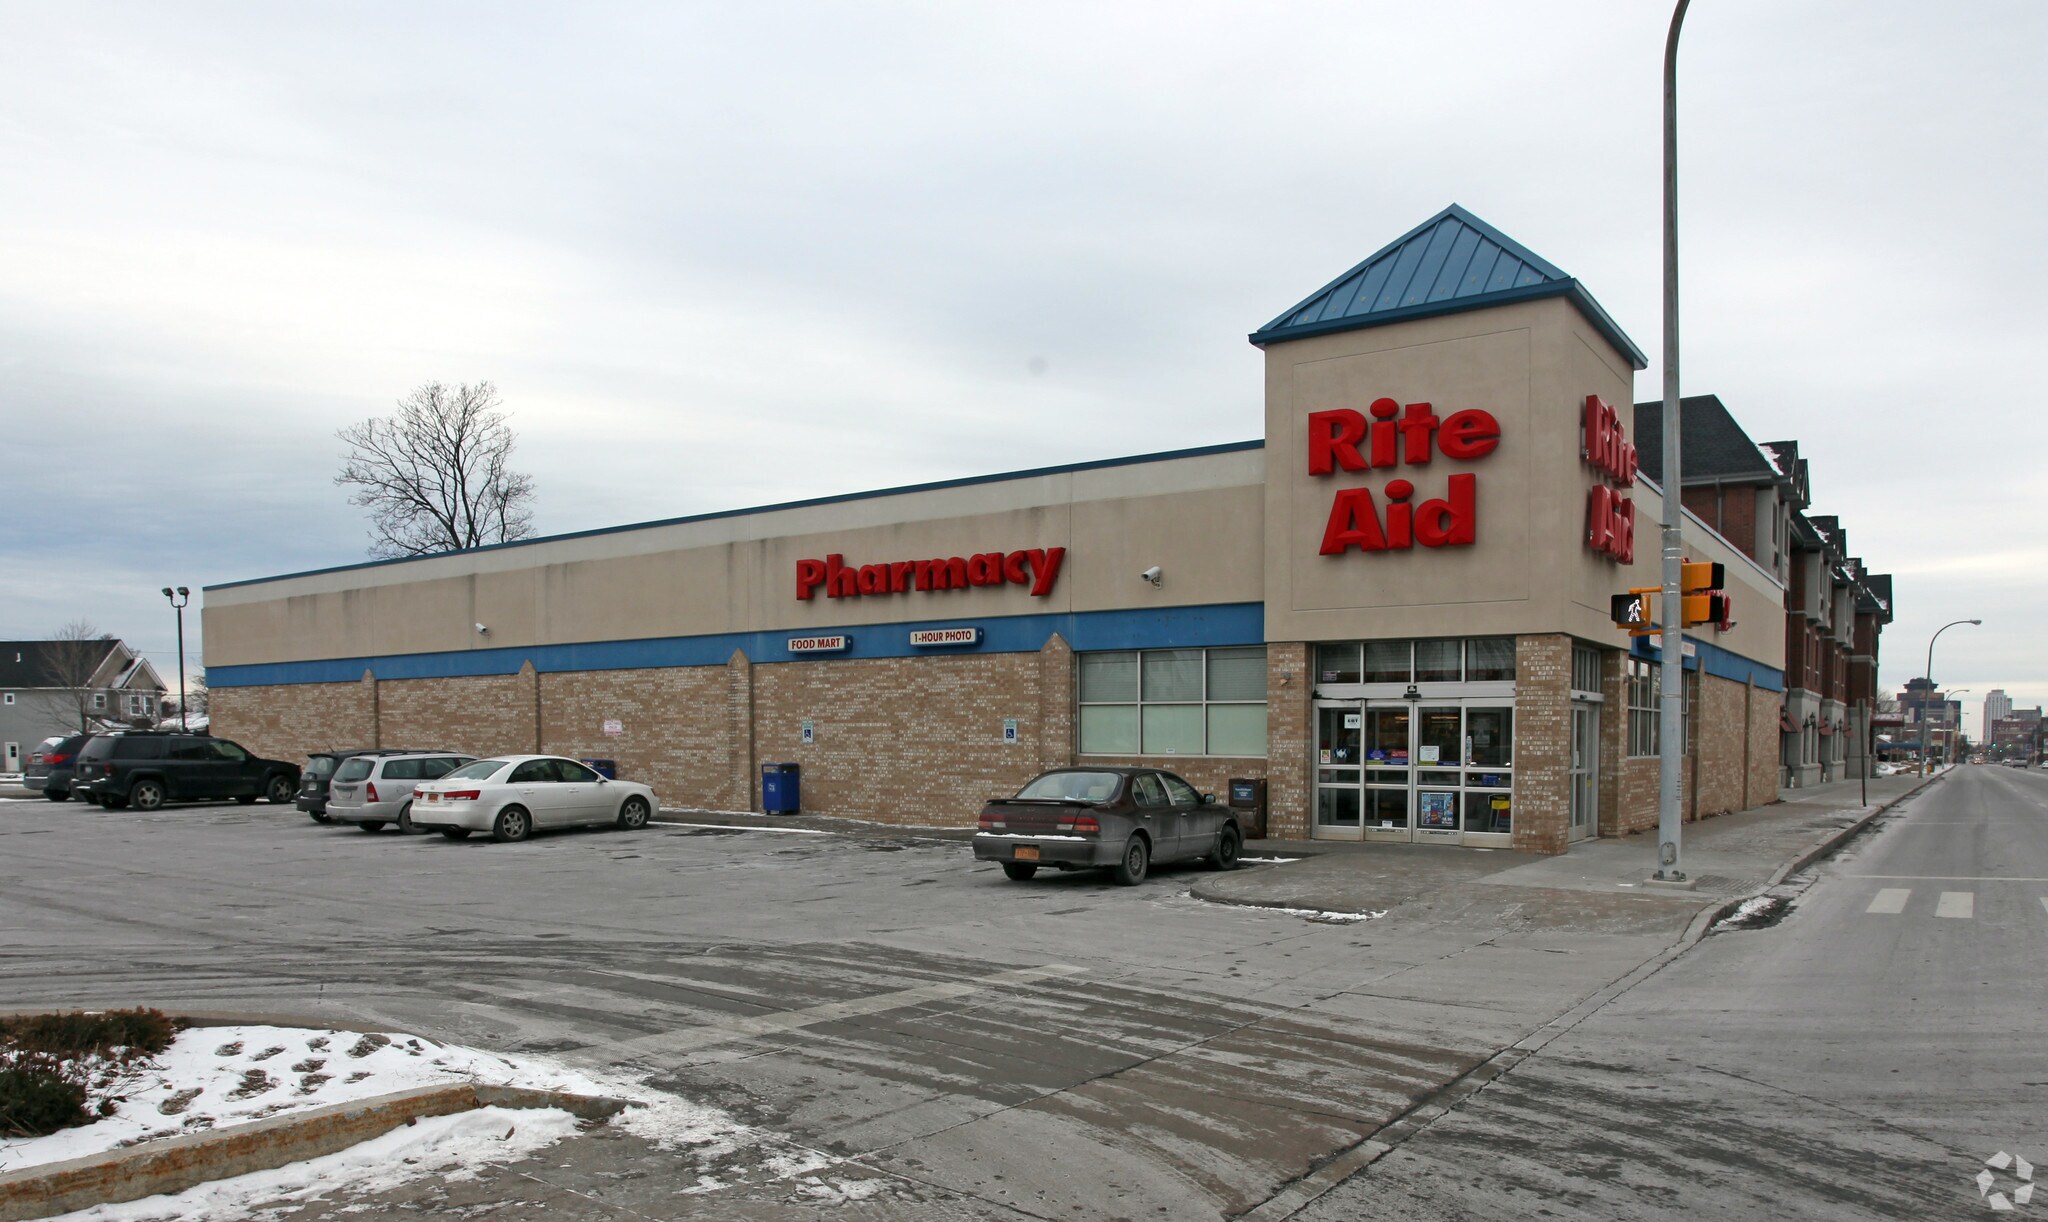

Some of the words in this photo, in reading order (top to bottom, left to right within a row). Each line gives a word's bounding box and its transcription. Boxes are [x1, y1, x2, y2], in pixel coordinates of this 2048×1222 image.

[1308, 397, 1501, 477] Rite
[1319, 473, 1476, 556] Aid
[796, 547, 1067, 601] Pharmacy
[791, 638, 815, 650] FOOD
[817, 637, 841, 649] MART
[914, 632, 944, 643] 1-HOUR
[945, 630, 972, 642] PHOTO
